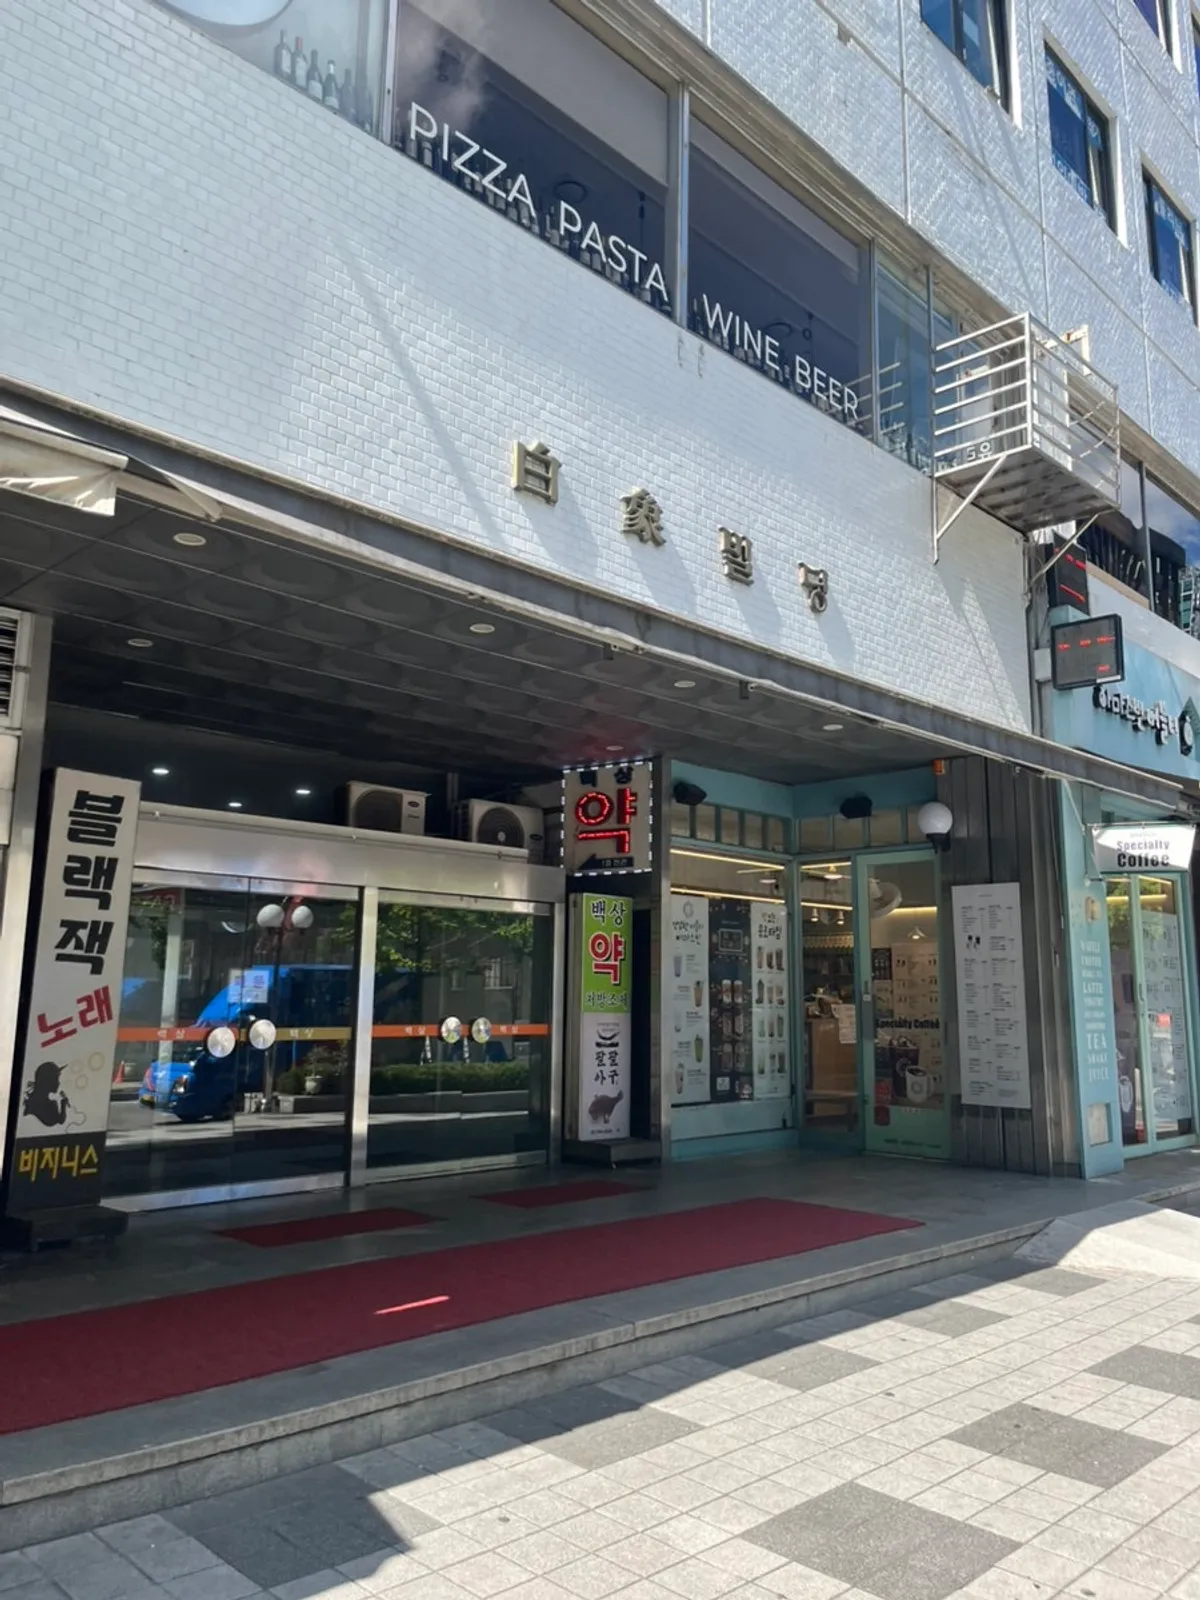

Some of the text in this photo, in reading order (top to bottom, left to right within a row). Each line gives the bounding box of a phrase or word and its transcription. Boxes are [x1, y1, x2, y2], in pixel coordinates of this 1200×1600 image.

[409, 101, 859, 420] PIZZA PASTA WINE BEER
[575, 787, 638, 854] 약
[1116, 840, 1171, 852] Specialty
[1117, 852, 1170, 868] Coffee
[54, 789, 125, 976] 블랙잭
[591, 898, 627, 926] 백상
[589, 931, 625, 985] 약
[36, 985, 113, 1048] 노래
[1086, 1032, 1108, 1050] TEA
[18, 1143, 100, 1183] 비지니스
